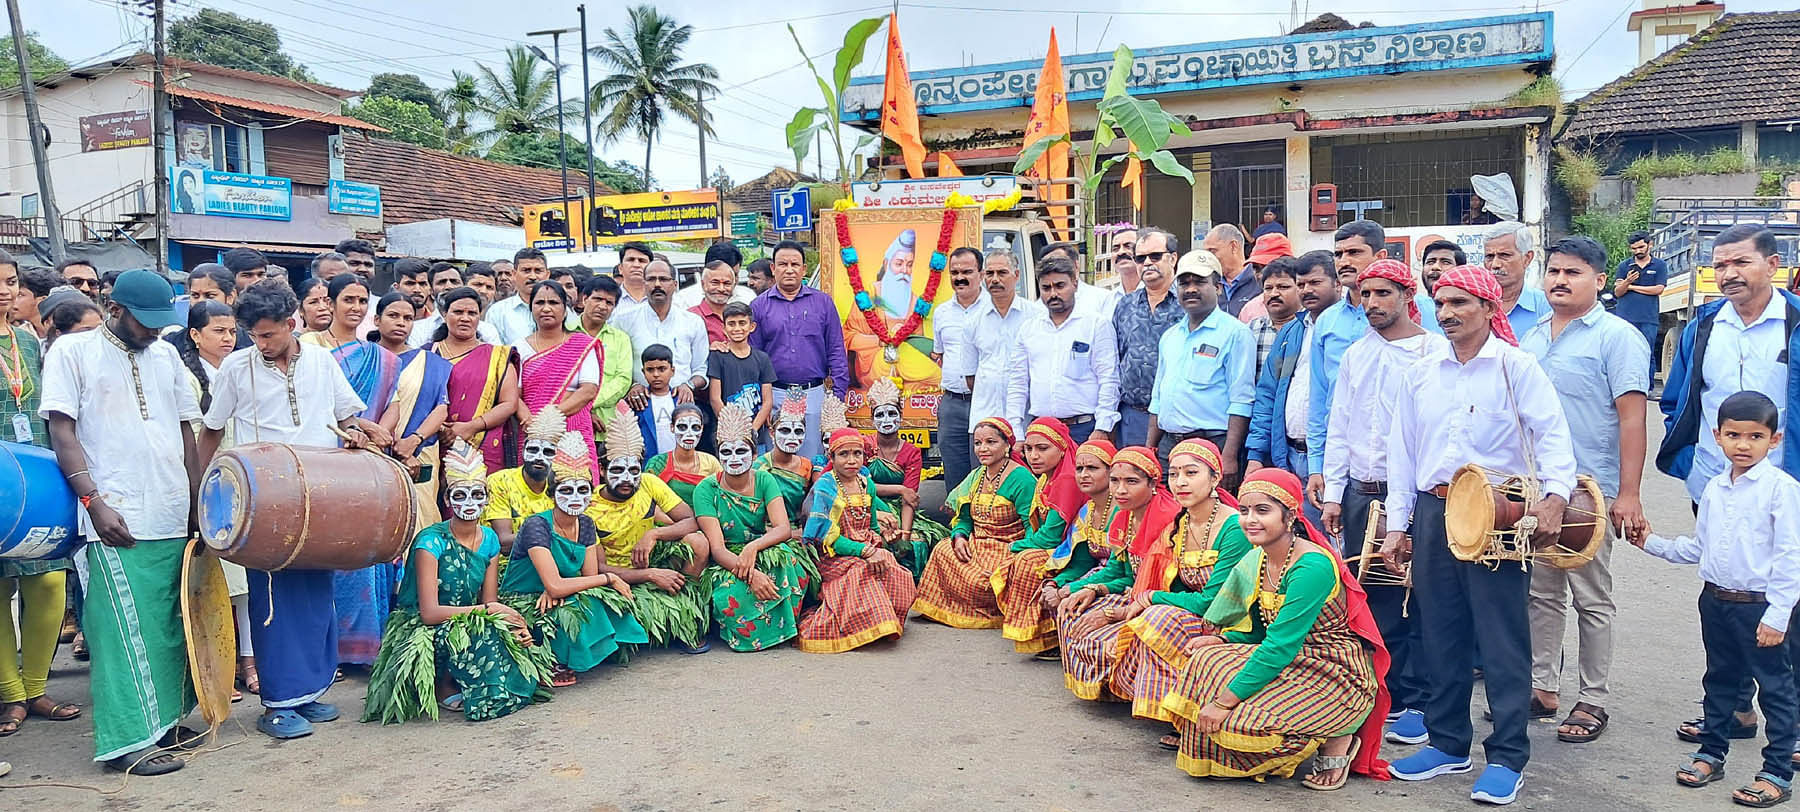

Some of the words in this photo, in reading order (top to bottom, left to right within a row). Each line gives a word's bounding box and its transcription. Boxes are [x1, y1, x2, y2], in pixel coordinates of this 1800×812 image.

[914, 71, 1038, 104] ನ್ನಂಪೇ
[1308, 37, 1376, 69] ಬಸ್
[208, 200, 231, 211] LADIES
[232, 201, 258, 213] BEAUTY
[259, 205, 288, 216] PARLOUR
[779, 194, 795, 217] P
[847, 389, 863, 413] ಶ್ರೀ
